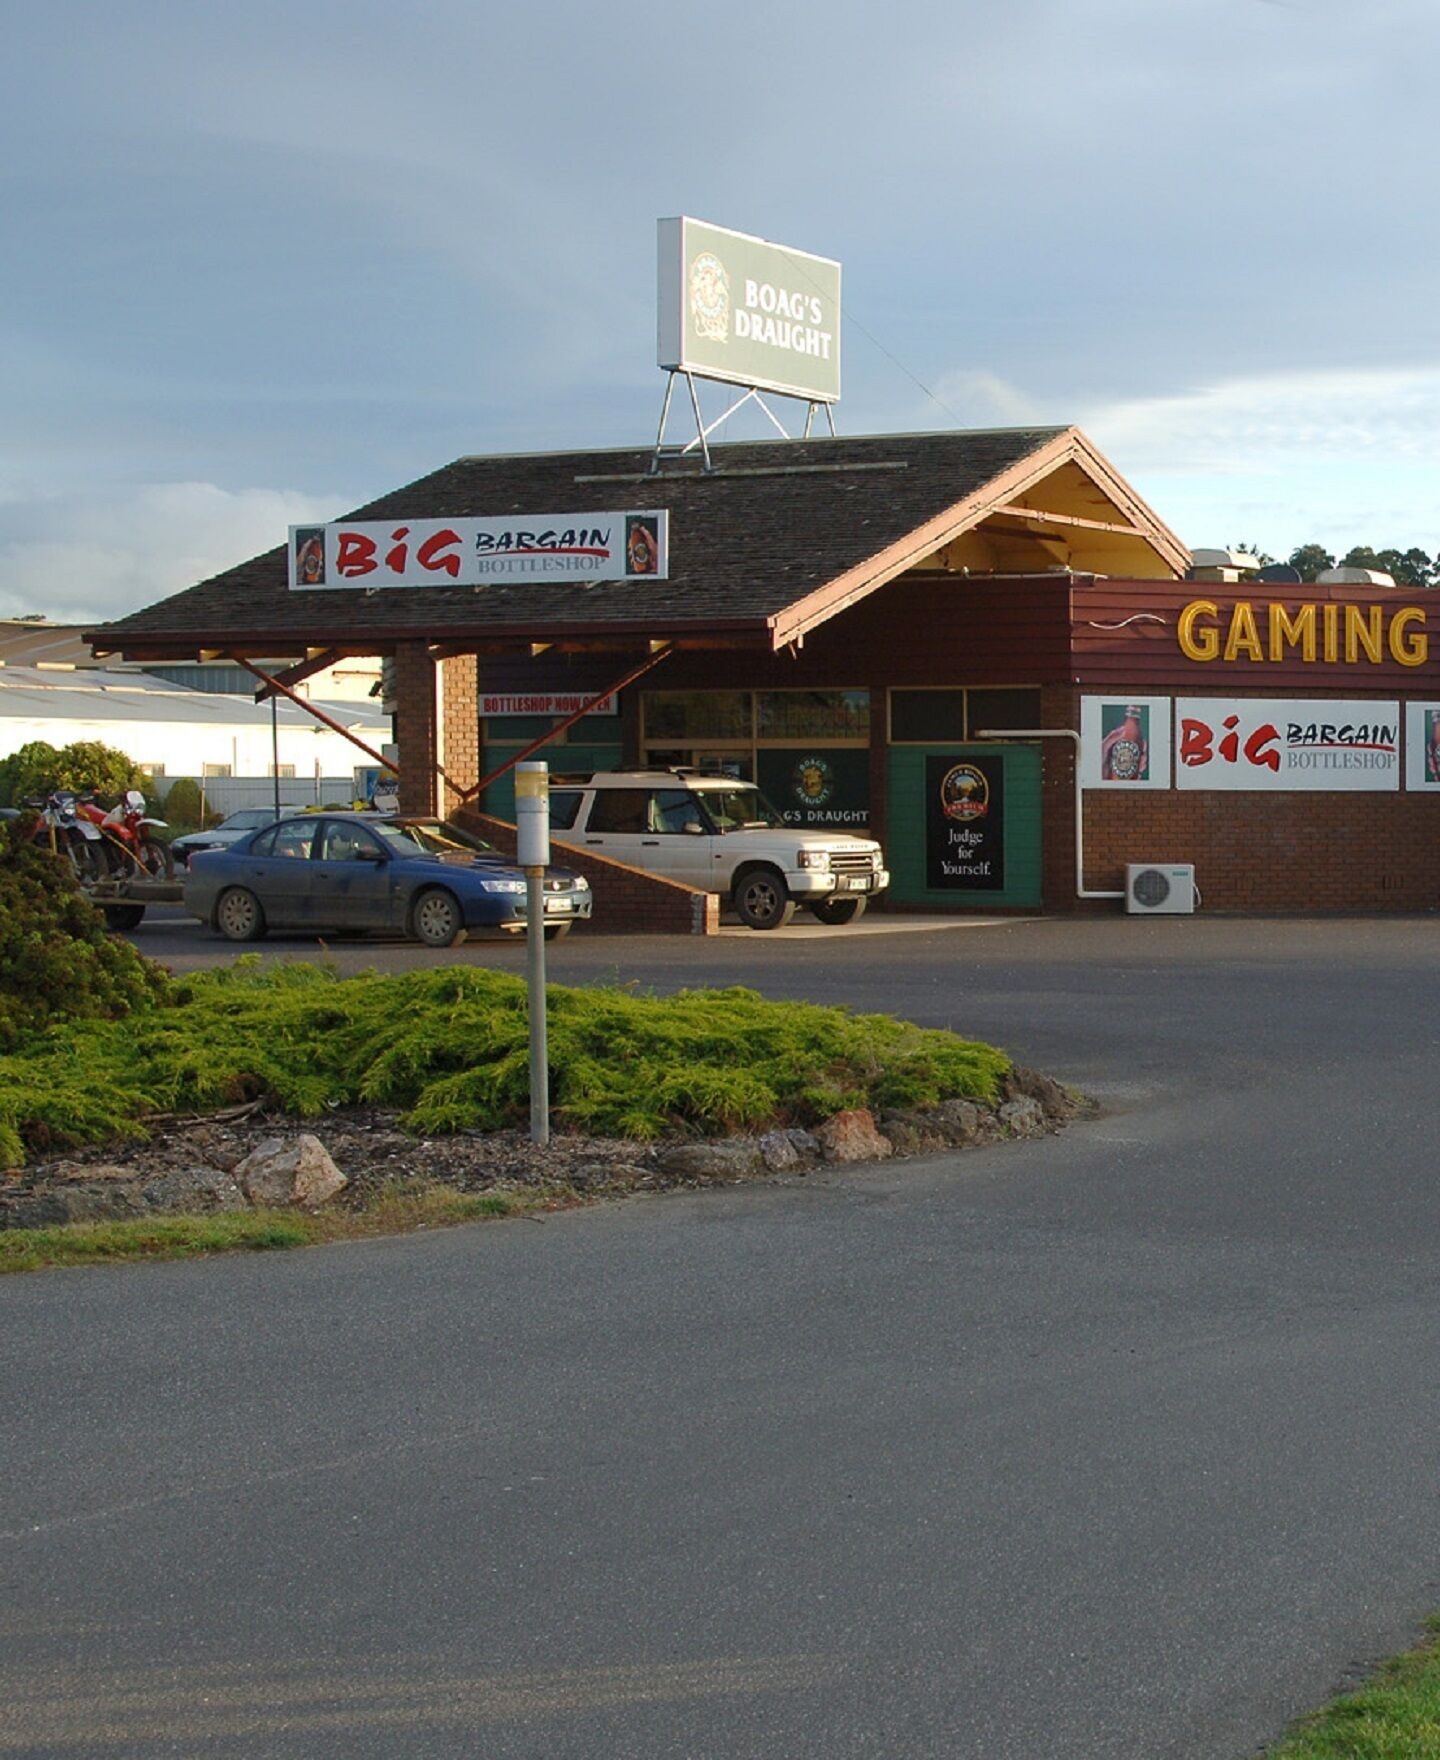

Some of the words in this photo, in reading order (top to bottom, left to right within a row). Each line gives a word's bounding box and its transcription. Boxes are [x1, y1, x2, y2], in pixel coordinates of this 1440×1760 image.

[745, 279, 822, 324] BOAG'S
[735, 309, 832, 359] DRAUGHT
[475, 528, 611, 551] BARGAIN
[478, 556, 606, 575] BOTTLESHOP
[1177, 600, 1430, 668] GAMING
[484, 697, 553, 713] BOTTLESHOP
[555, 696, 580, 712] NOW
[1286, 722, 1397, 745] BARGAIN
[1287, 752, 1397, 770] BOTTLESHOP
[807, 810, 870, 822] DRAUGHT
[948, 828, 984, 845] Judge
[957, 846, 975, 860] for
[941, 860, 991, 876] Yourself.
